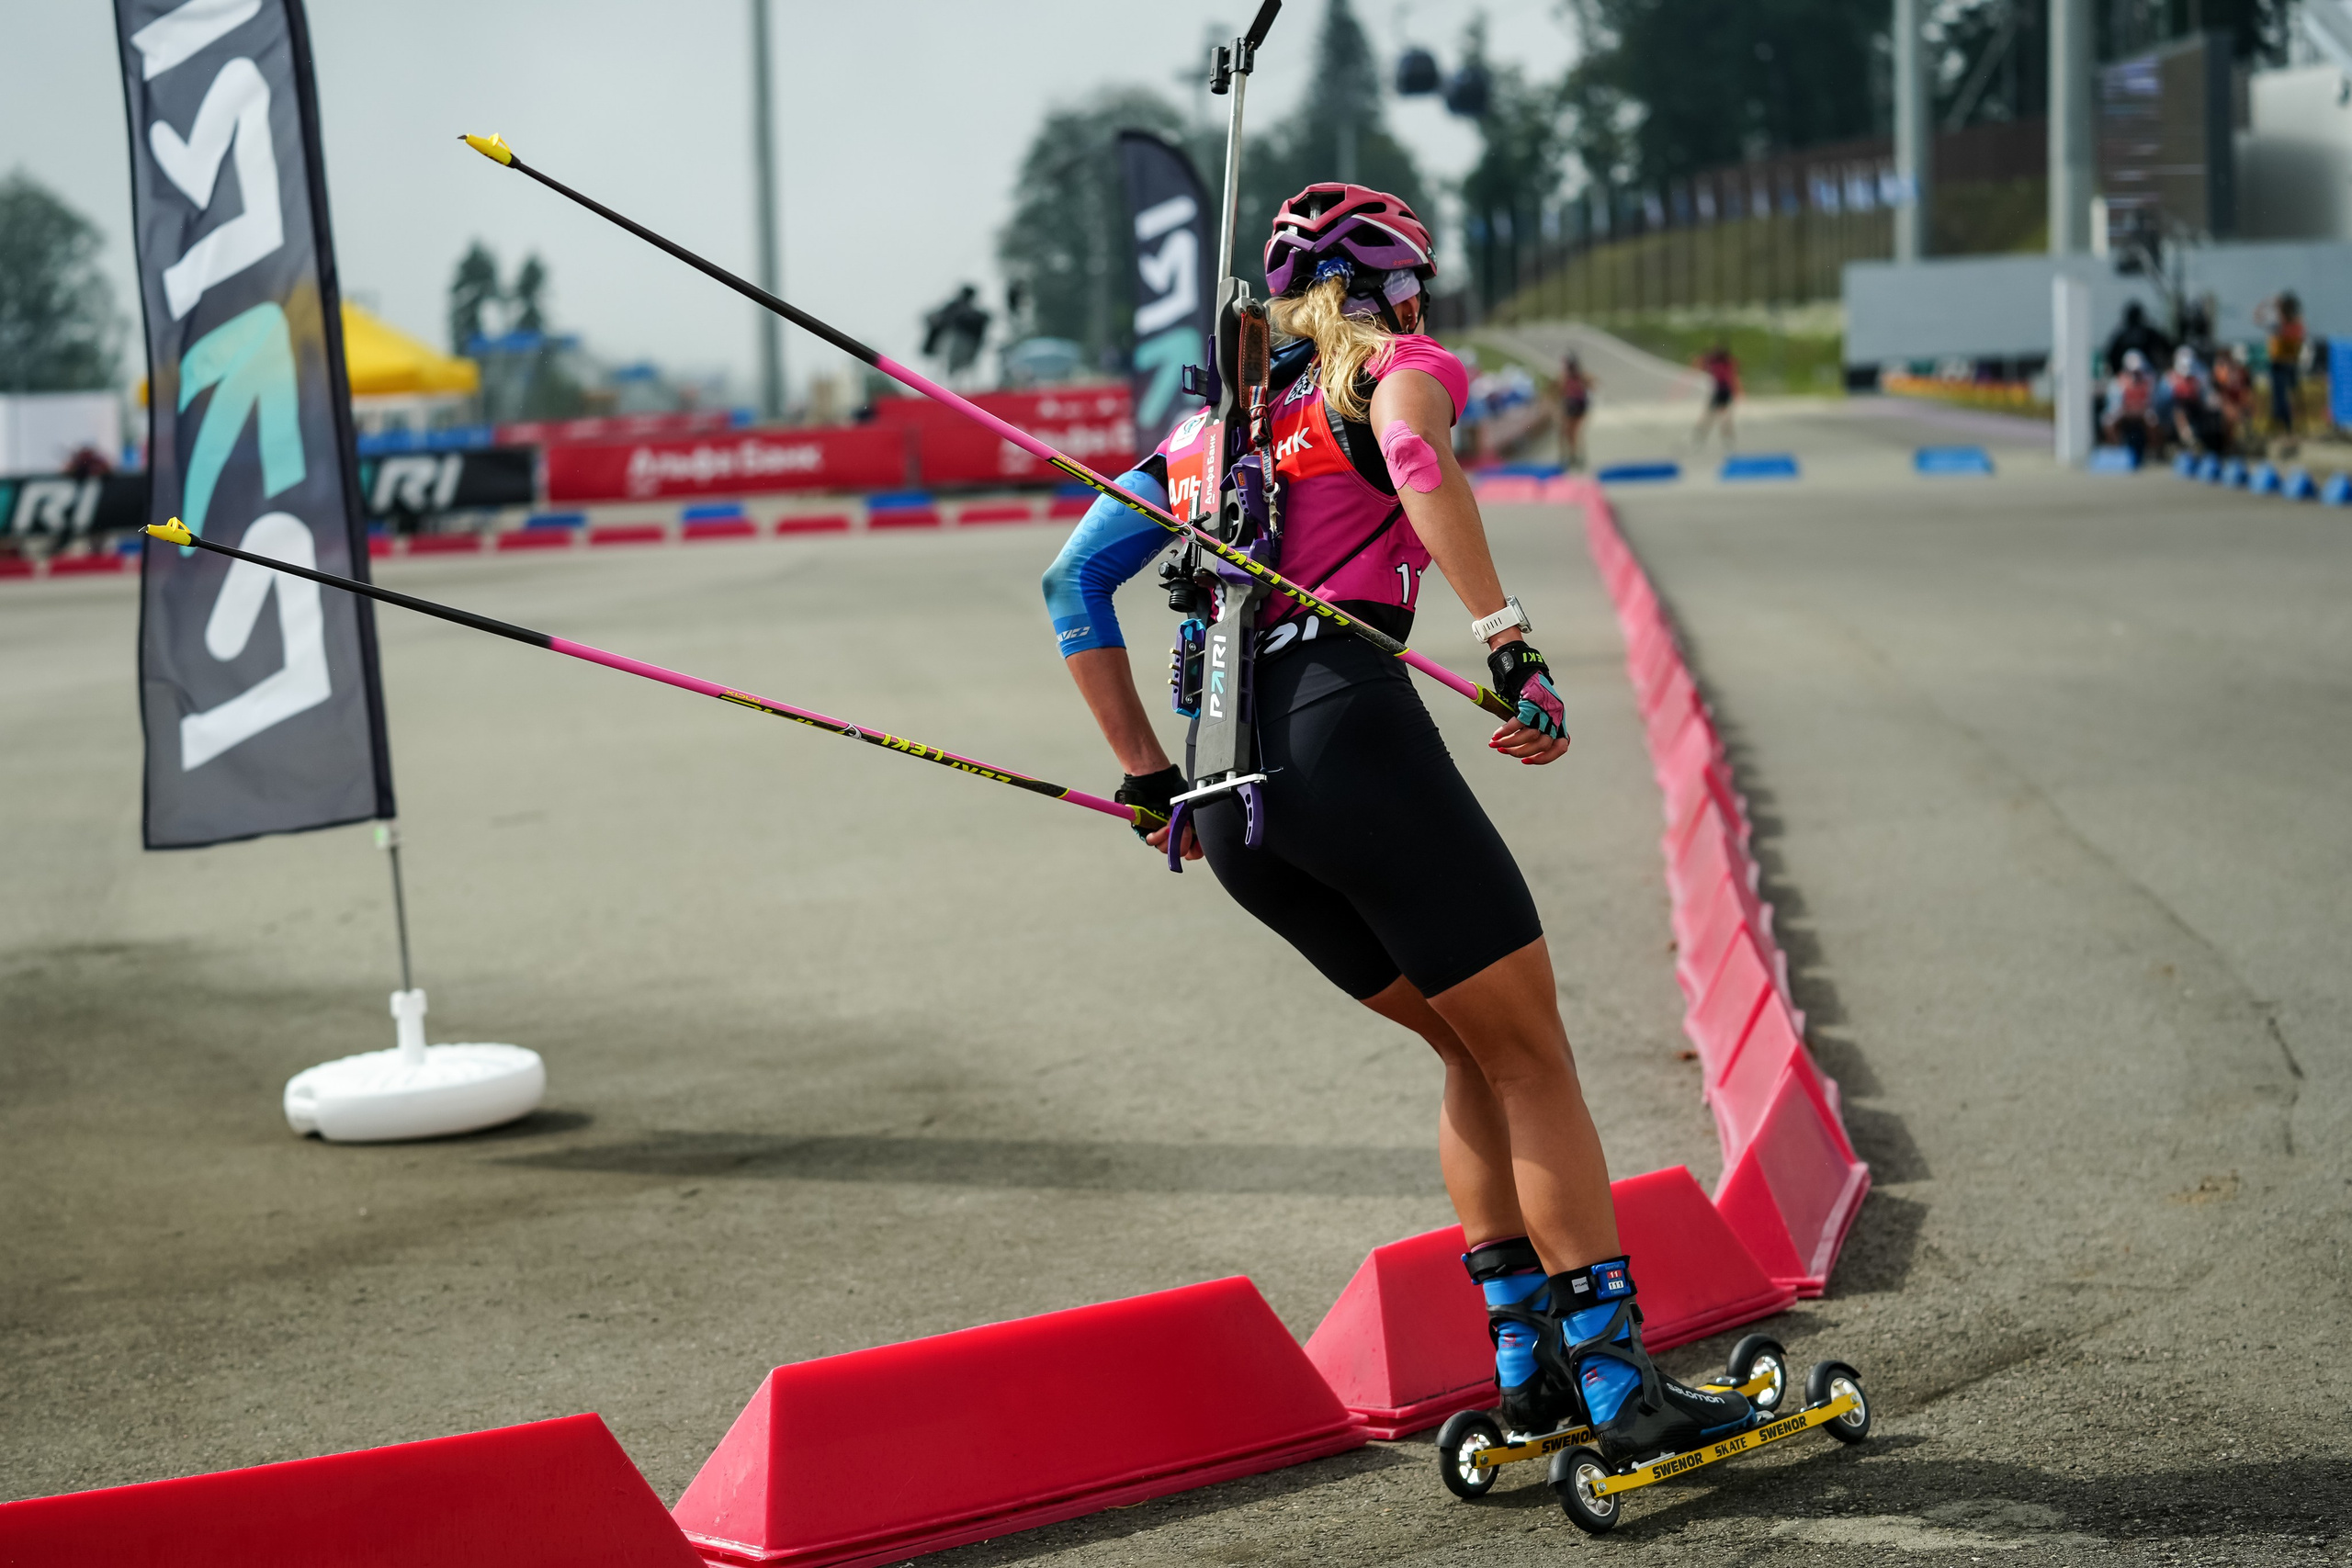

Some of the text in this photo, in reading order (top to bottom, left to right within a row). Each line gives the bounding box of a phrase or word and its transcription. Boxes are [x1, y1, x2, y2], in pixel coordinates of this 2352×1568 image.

[364, 456, 465, 512] RI
[1204, 434, 1216, 504] Альфа Банк
[3, 479, 103, 535] RI
[1395, 562, 1420, 606] 1
[1209, 635, 1227, 718] PARI
[1652, 1416, 1807, 1479] SWENOR SKATE SWENOR
